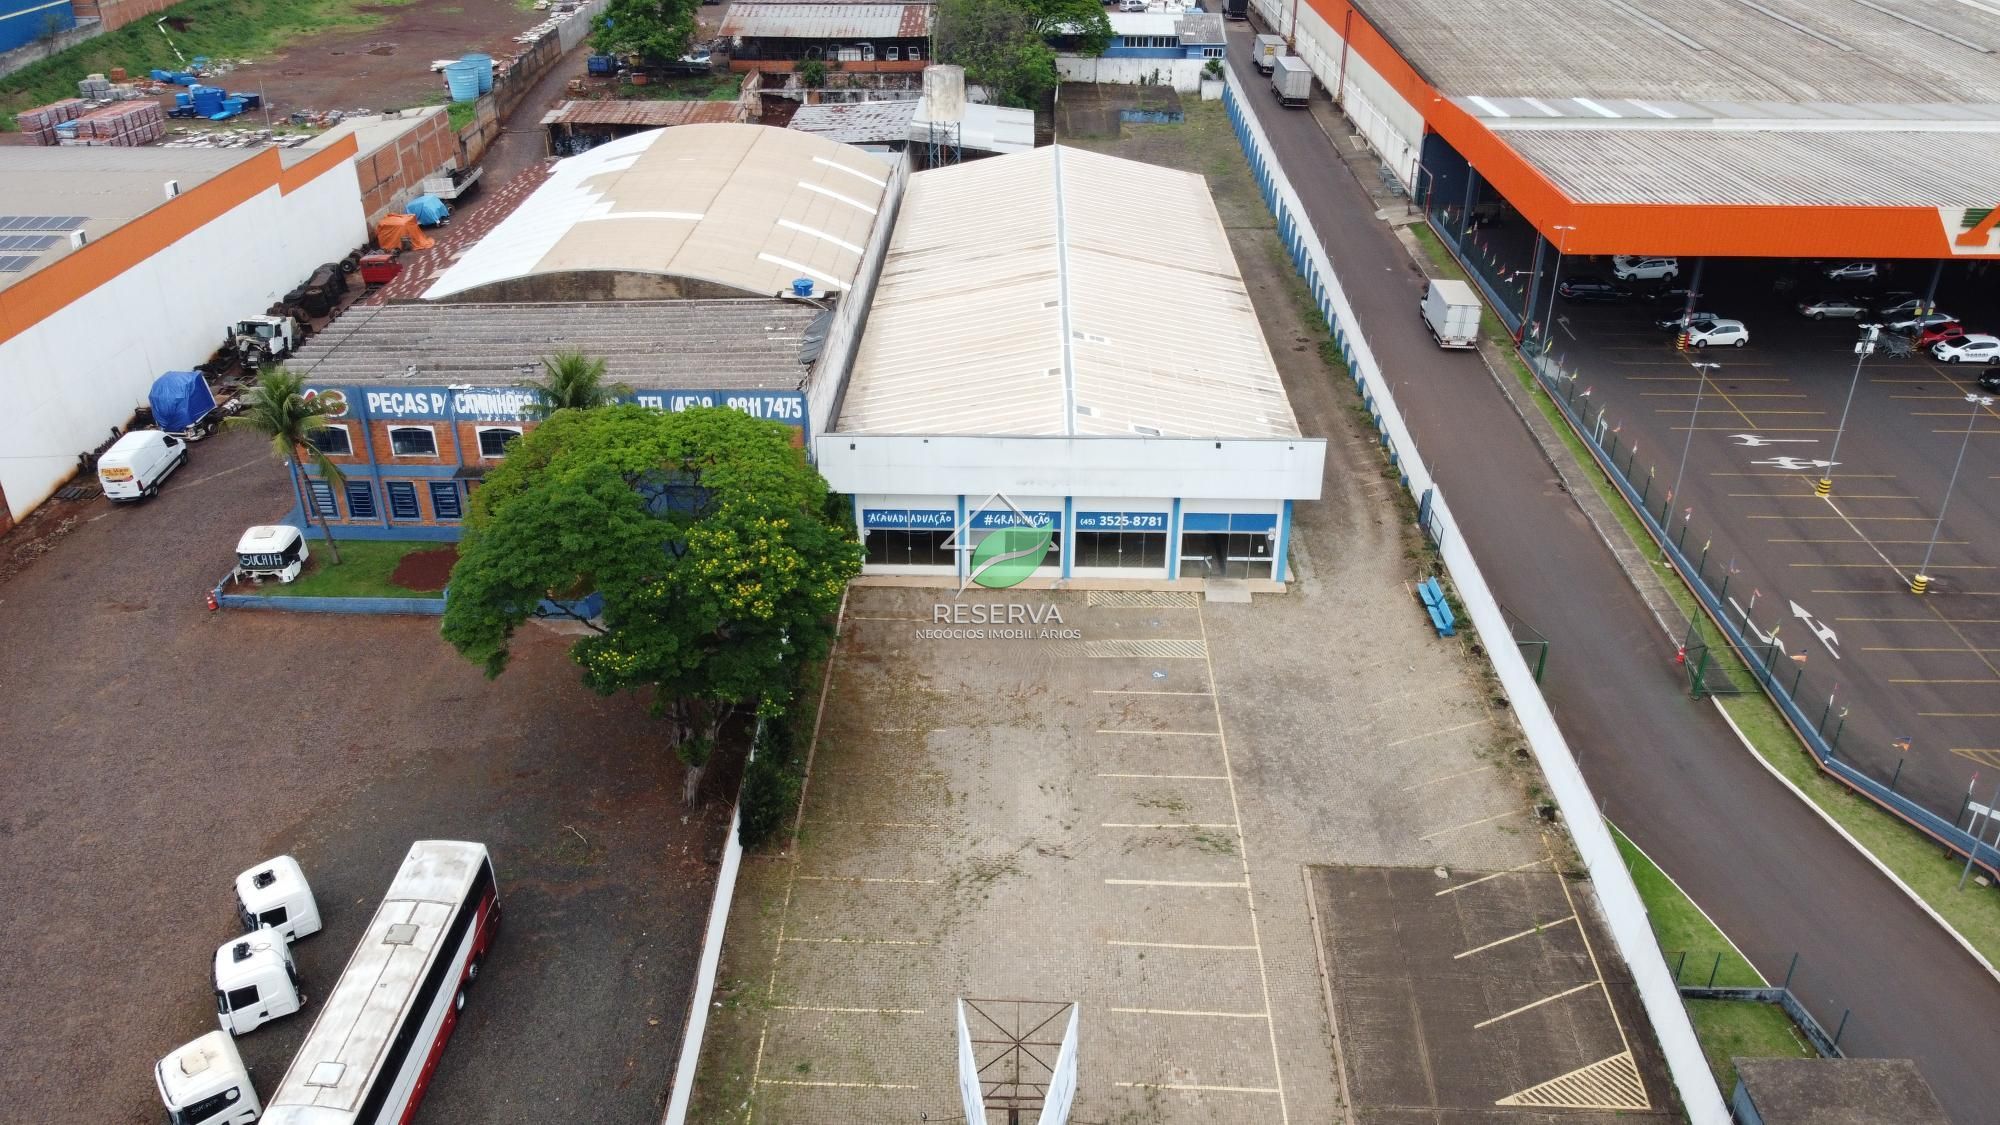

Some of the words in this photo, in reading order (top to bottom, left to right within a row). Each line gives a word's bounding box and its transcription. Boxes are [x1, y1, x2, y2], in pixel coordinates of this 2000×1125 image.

[367, 392, 430, 417] PEÇAS
[431, 393, 448, 415] P/
[764, 397, 802, 418] 7475
[1080, 518, 1096, 526] (45)
[1099, 515, 1162, 527] 3525-8781
